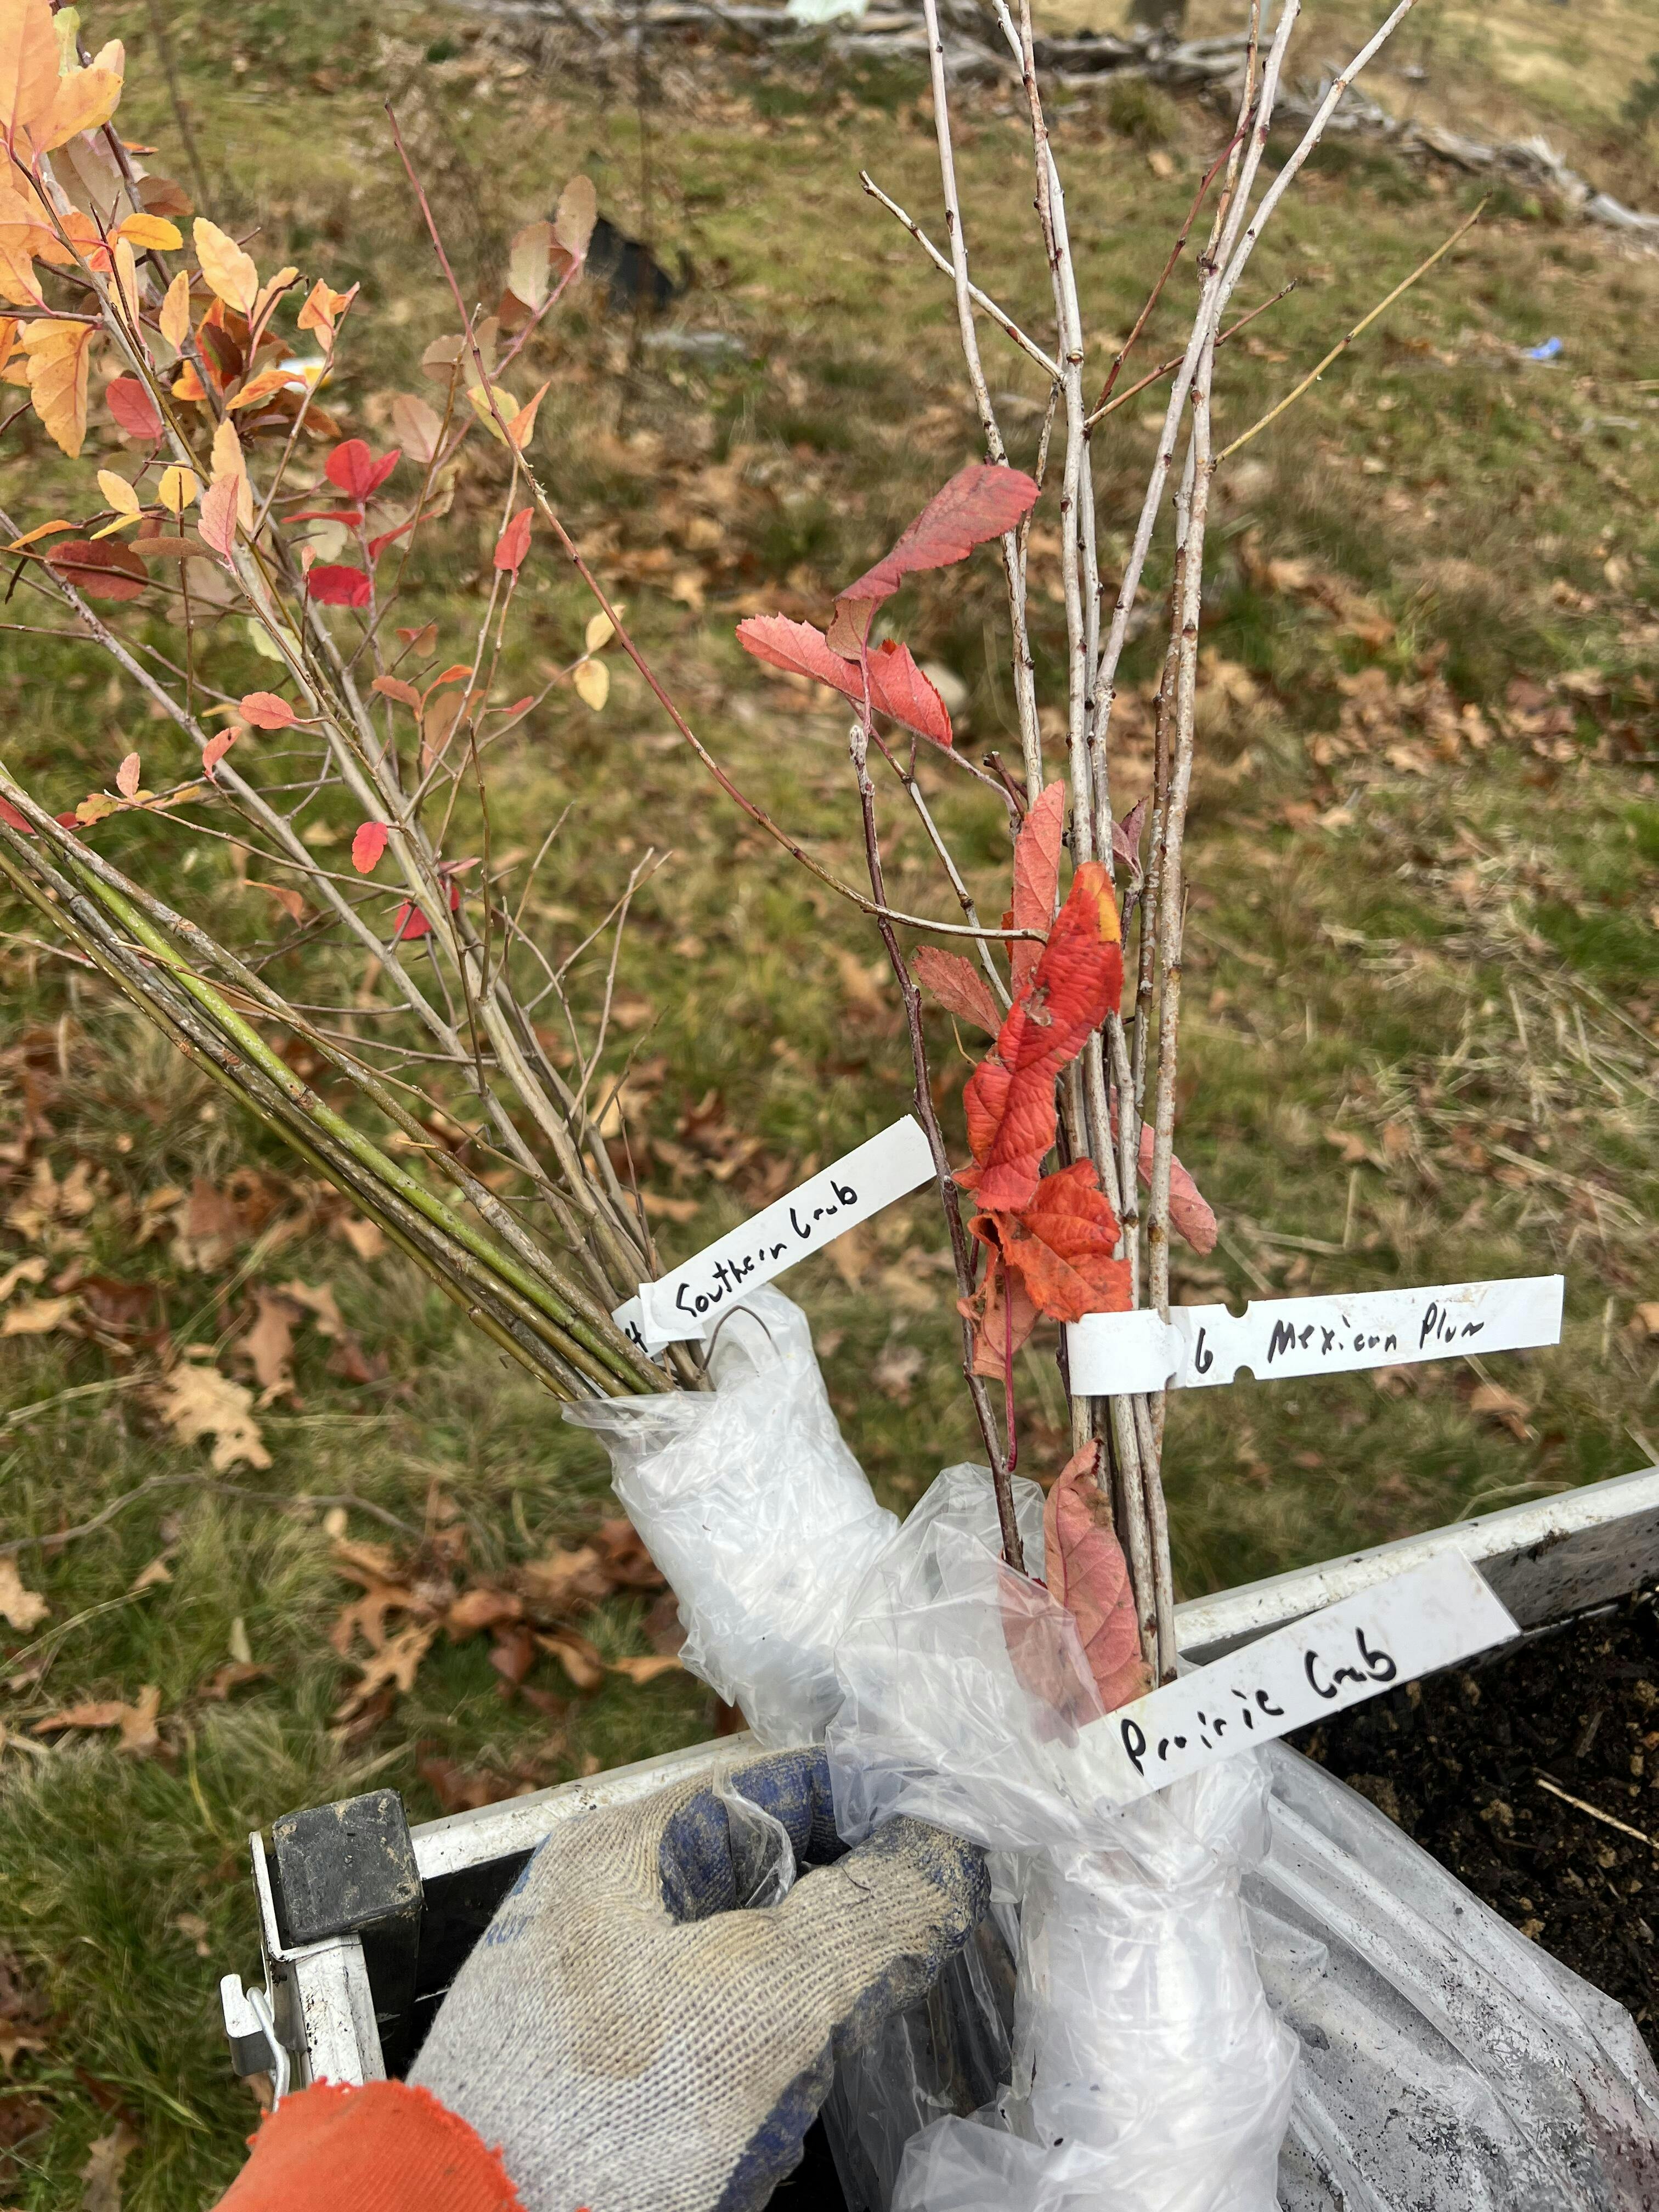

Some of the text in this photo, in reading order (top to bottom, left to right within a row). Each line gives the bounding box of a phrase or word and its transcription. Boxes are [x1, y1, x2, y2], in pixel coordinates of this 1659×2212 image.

[675, 1243, 788, 1318] Southern
[789, 1180, 858, 1239] Crab
[1195, 1328, 1214, 1374] 6
[1267, 1314, 1397, 1364] Mexican
[1120, 1627, 1397, 1776] Prairie Crab
